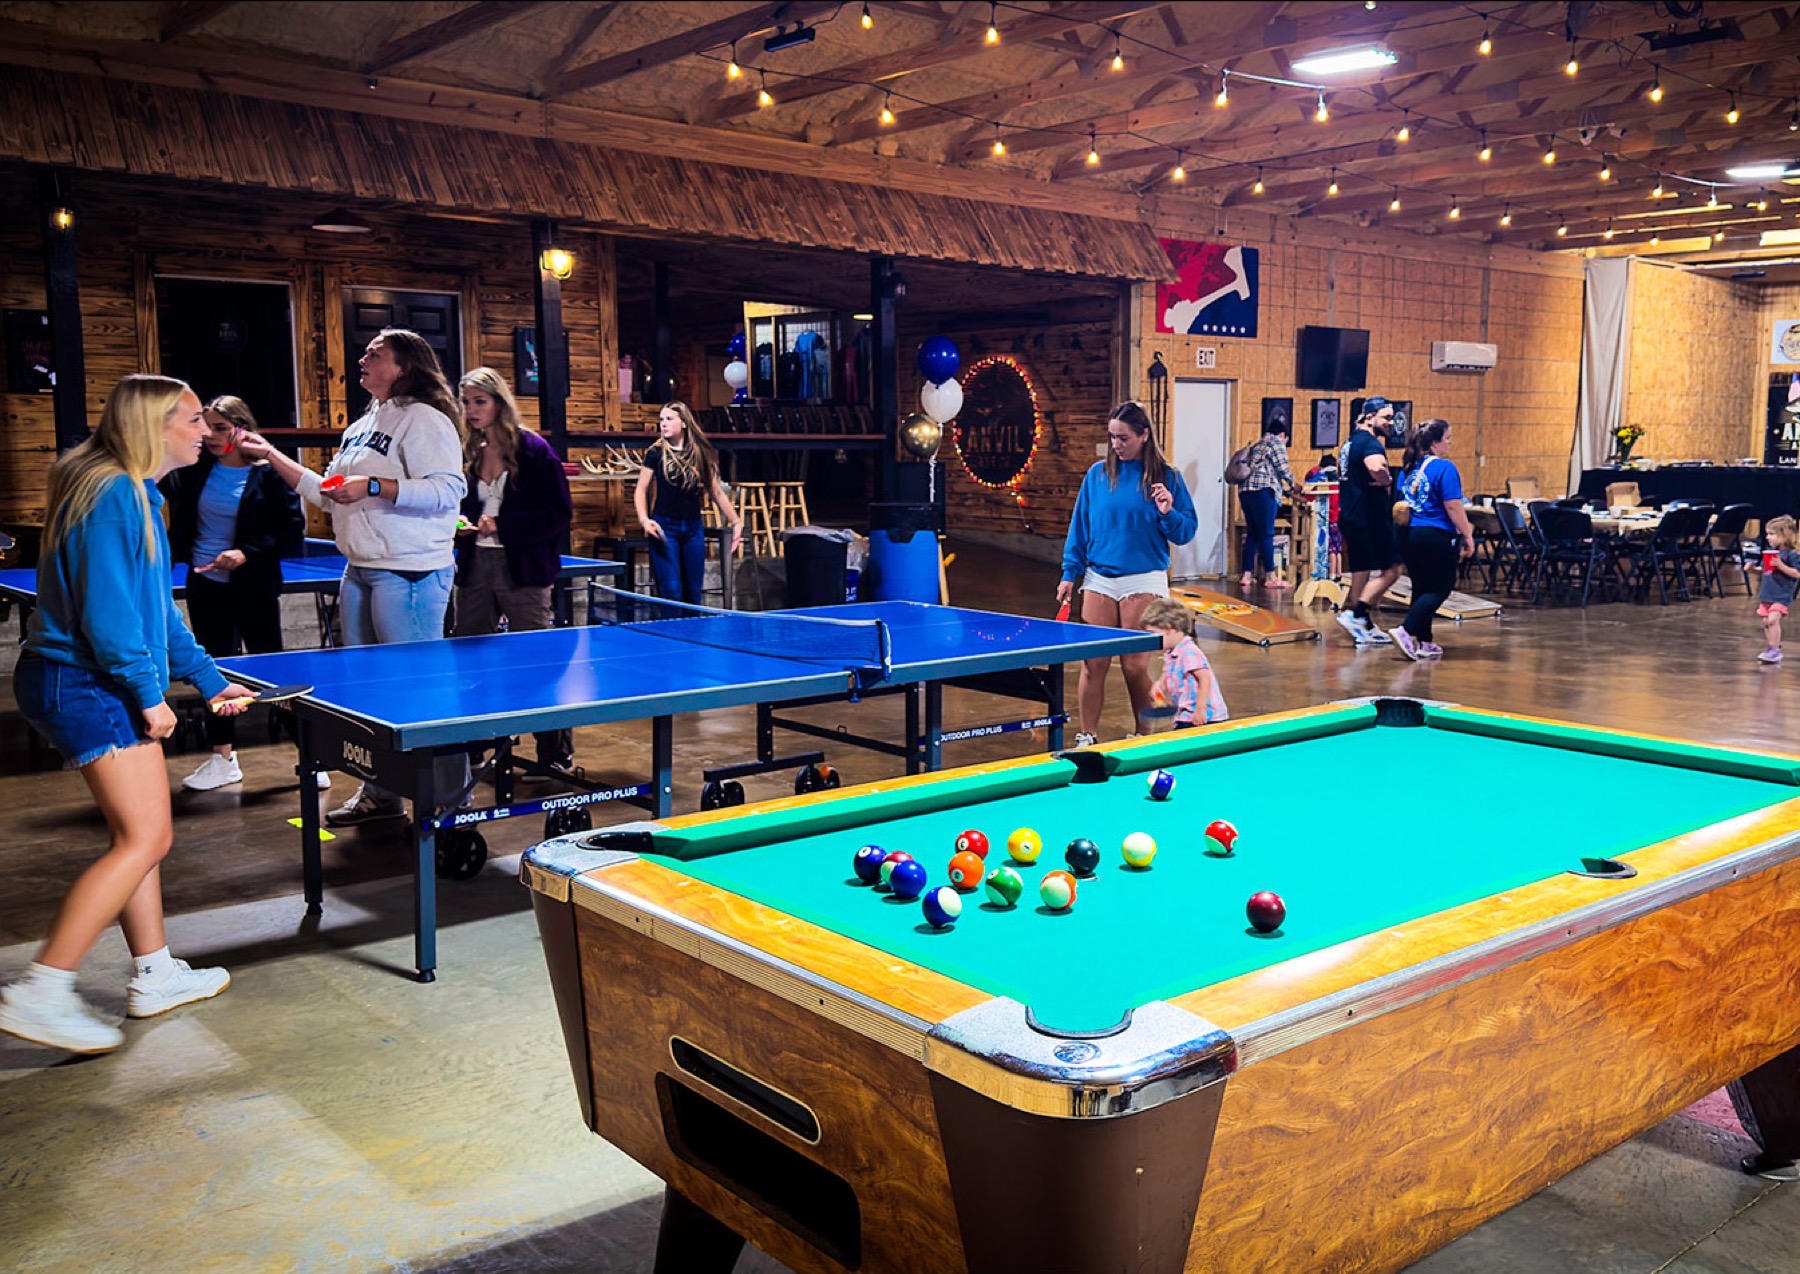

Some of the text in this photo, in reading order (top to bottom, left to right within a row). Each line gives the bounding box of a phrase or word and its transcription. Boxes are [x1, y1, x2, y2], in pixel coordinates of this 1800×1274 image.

[1199, 350, 1215, 366] EXIT
[966, 425, 1025, 453] ANVIL
[985, 725, 1002, 735] PLUS
[342, 740, 373, 769] JOOLA
[541, 787, 637, 810] OUTDOOR PRO PLUS
[454, 810, 487, 825] JOOLA
